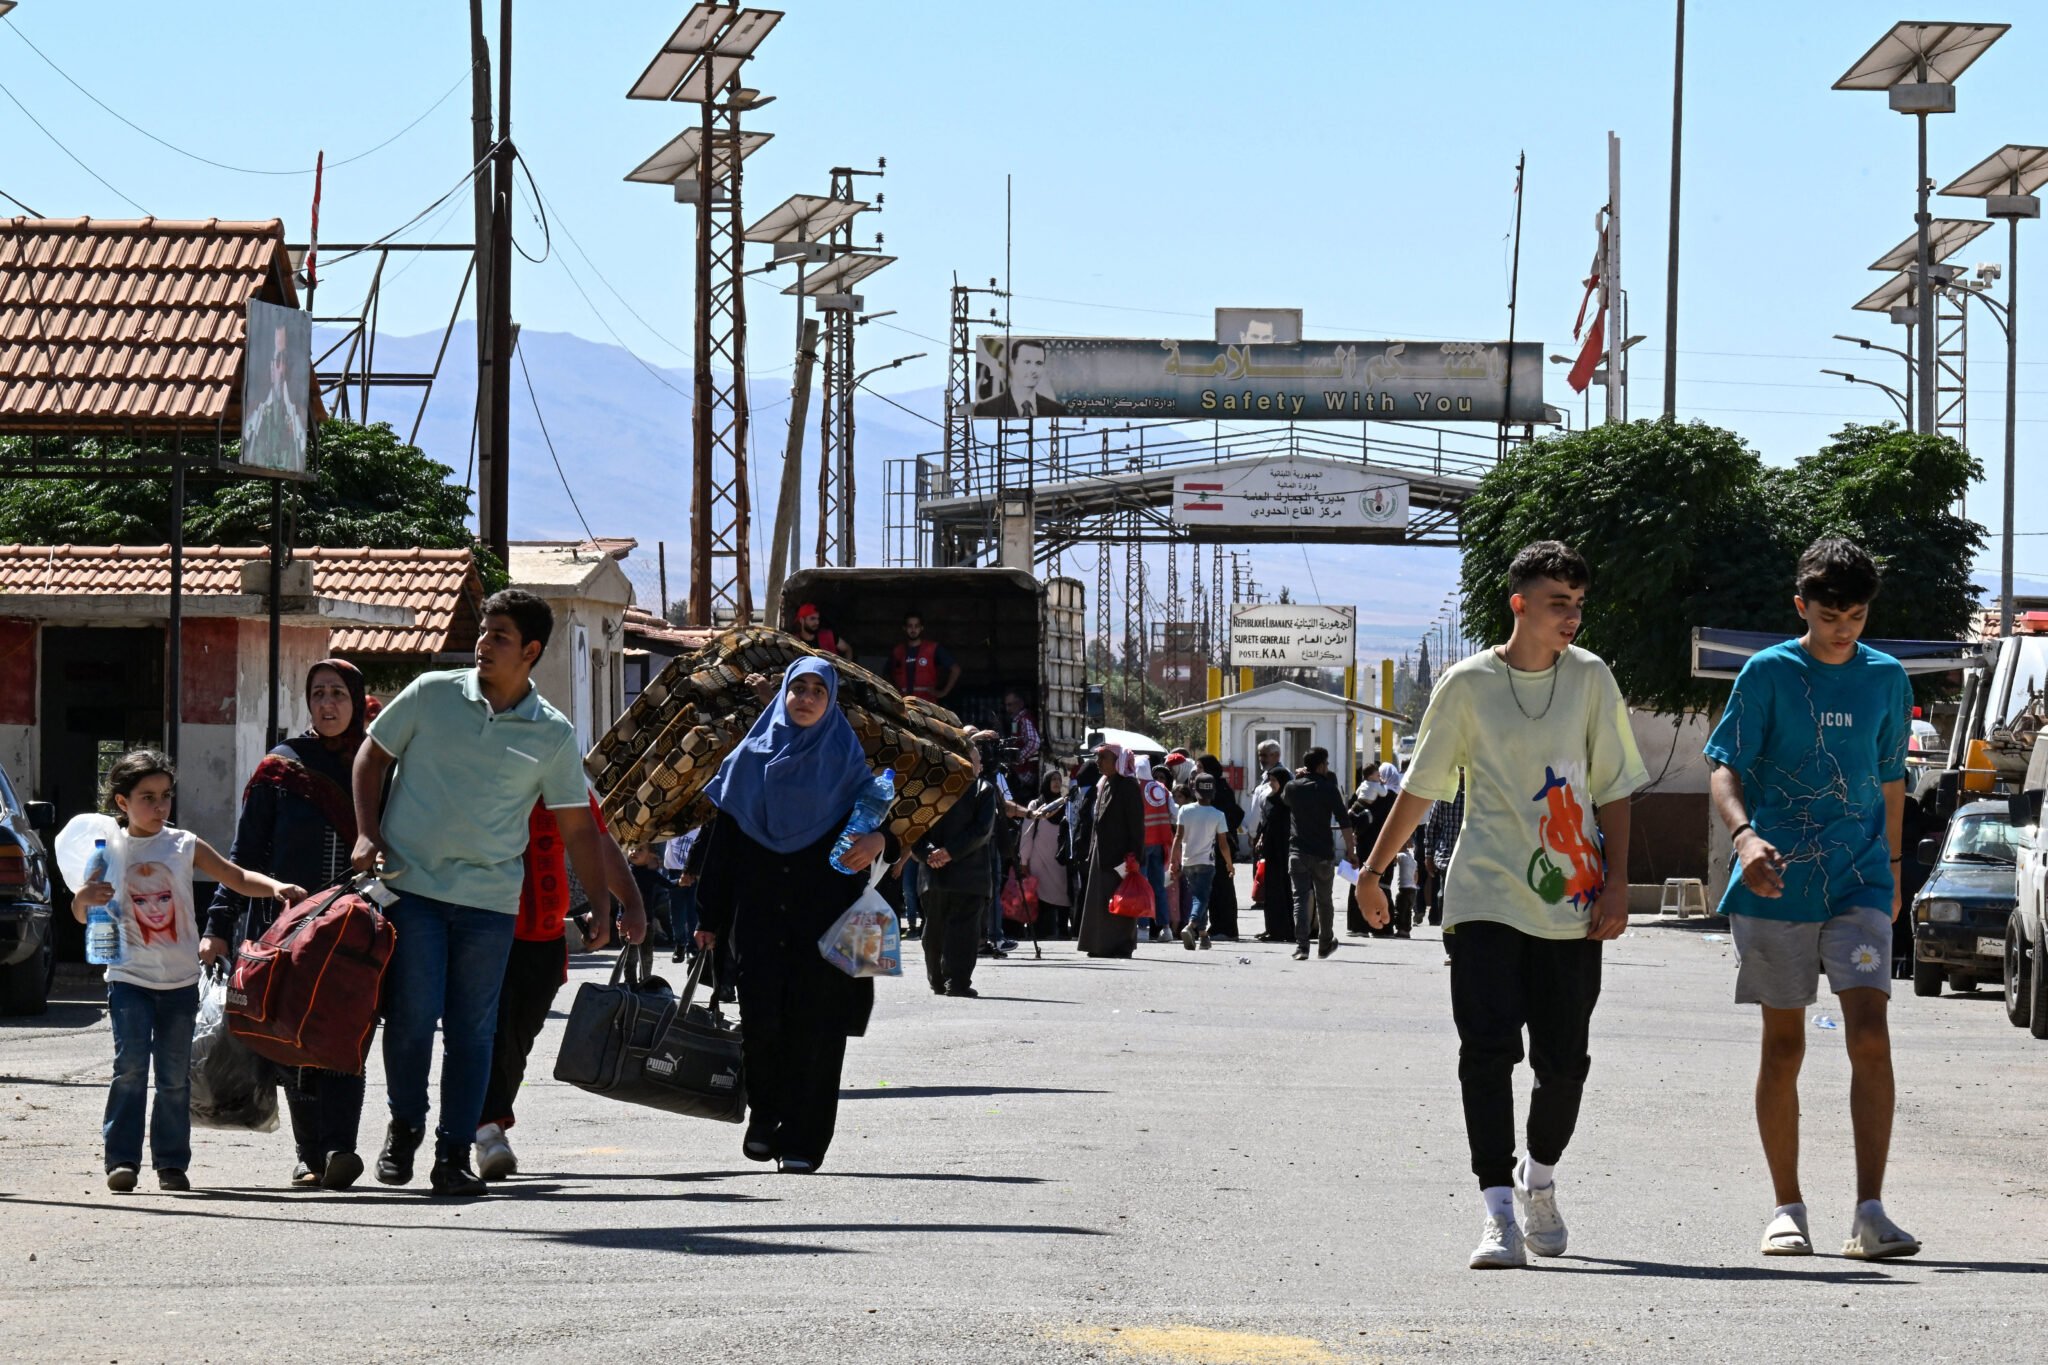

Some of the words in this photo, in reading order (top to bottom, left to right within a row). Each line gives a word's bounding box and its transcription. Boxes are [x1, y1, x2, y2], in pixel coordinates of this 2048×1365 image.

[1160, 338, 1356, 380] السلامة
[1067, 397, 1110, 409] الحدودي
[1112, 397, 1151, 409] المركز
[1154, 397, 1175, 410] إدارة
[1200, 388, 1305, 415] Safety
[1323, 389, 1396, 412] With
[1413, 390, 1472, 413] You
[1270, 469, 1291, 478] اللبنانية
[1293, 469, 1323, 479] الجمهورية
[1277, 480, 1296, 489] المالية
[1298, 482, 1317, 491] وزارة
[1273, 491, 1310, 504] الجمارك
[1314, 491, 1345, 505] مديرية
[1250, 505, 1290, 519] الحدودي
[1291, 506, 1314, 520] القاع
[1319, 506, 1342, 519] مركز
[1294, 617, 1318, 630] اللبنانية
[1319, 617, 1352, 631] الجمهورية
[1234, 634, 1259, 645] SURETE
[1259, 635, 1290, 645] GENERALE
[1297, 634, 1322, 646] العام
[1324, 633, 1347, 646] الأمن
[1301, 650, 1319, 661] القاع
[1318, 650, 1343, 661] مركز
[1820, 711, 1853, 727] ICON
[646, 1057, 674, 1074] PUMA
